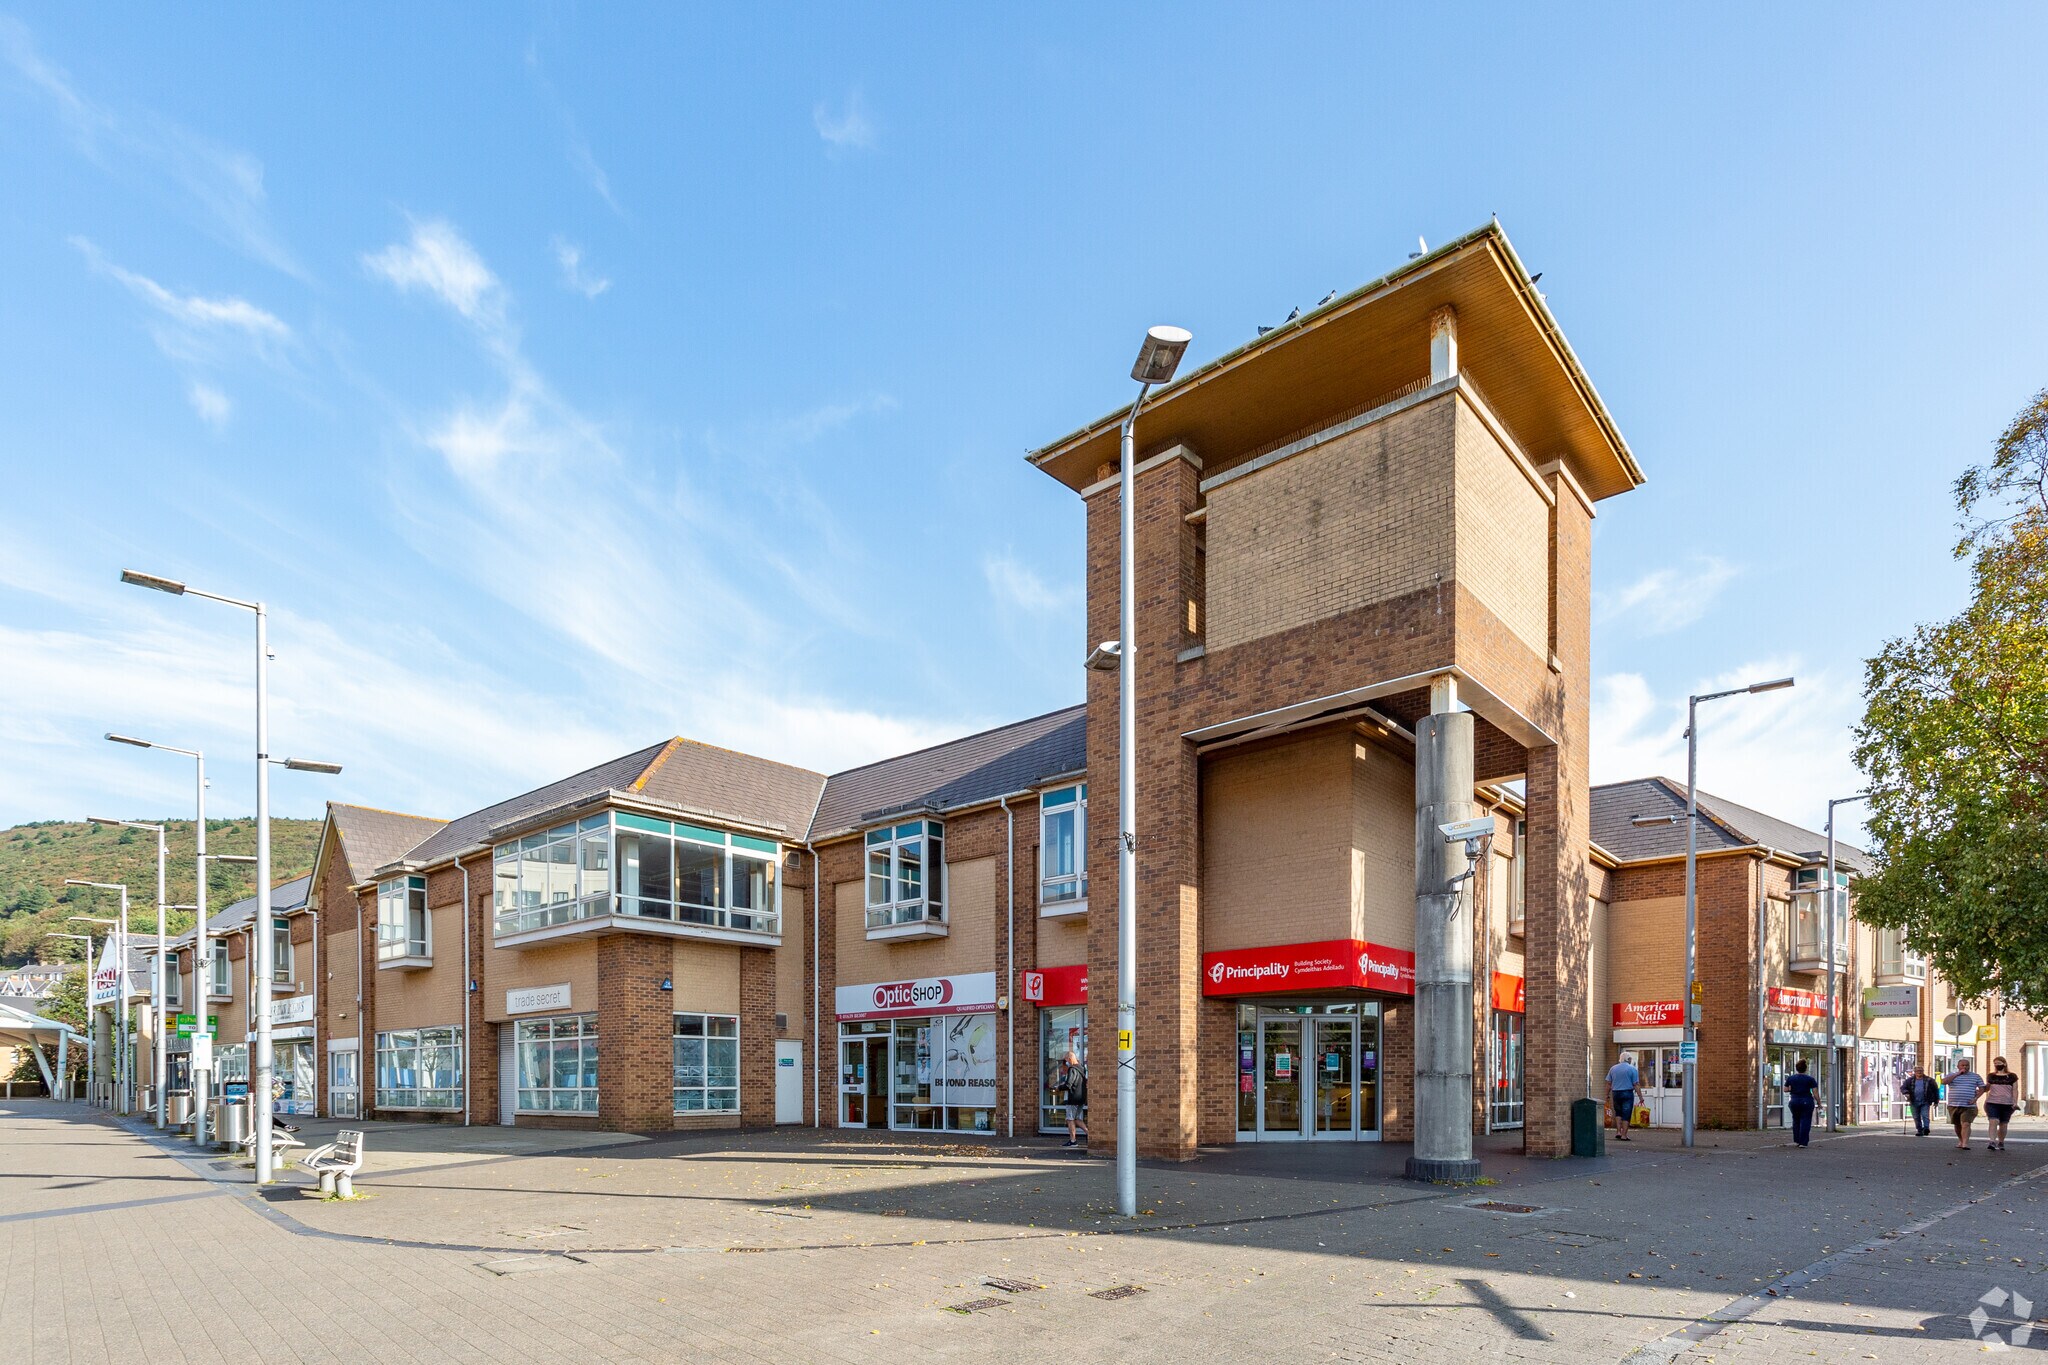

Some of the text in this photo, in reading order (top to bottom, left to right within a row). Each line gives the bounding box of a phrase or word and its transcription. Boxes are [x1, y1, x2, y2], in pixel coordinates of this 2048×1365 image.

[1226, 962, 1289, 980] Principality
[1294, 966, 1322, 974] Cymdeithas
[1368, 959, 1399, 980] Principality
[515, 990, 560, 1007] trade secret
[1778, 989, 1811, 1008] American
[1624, 1002, 1680, 1012] American
[1636, 1010, 1667, 1021] Nails
[1119, 1032, 1130, 1048] H
[935, 1078, 996, 1087] BEYOND REASO
